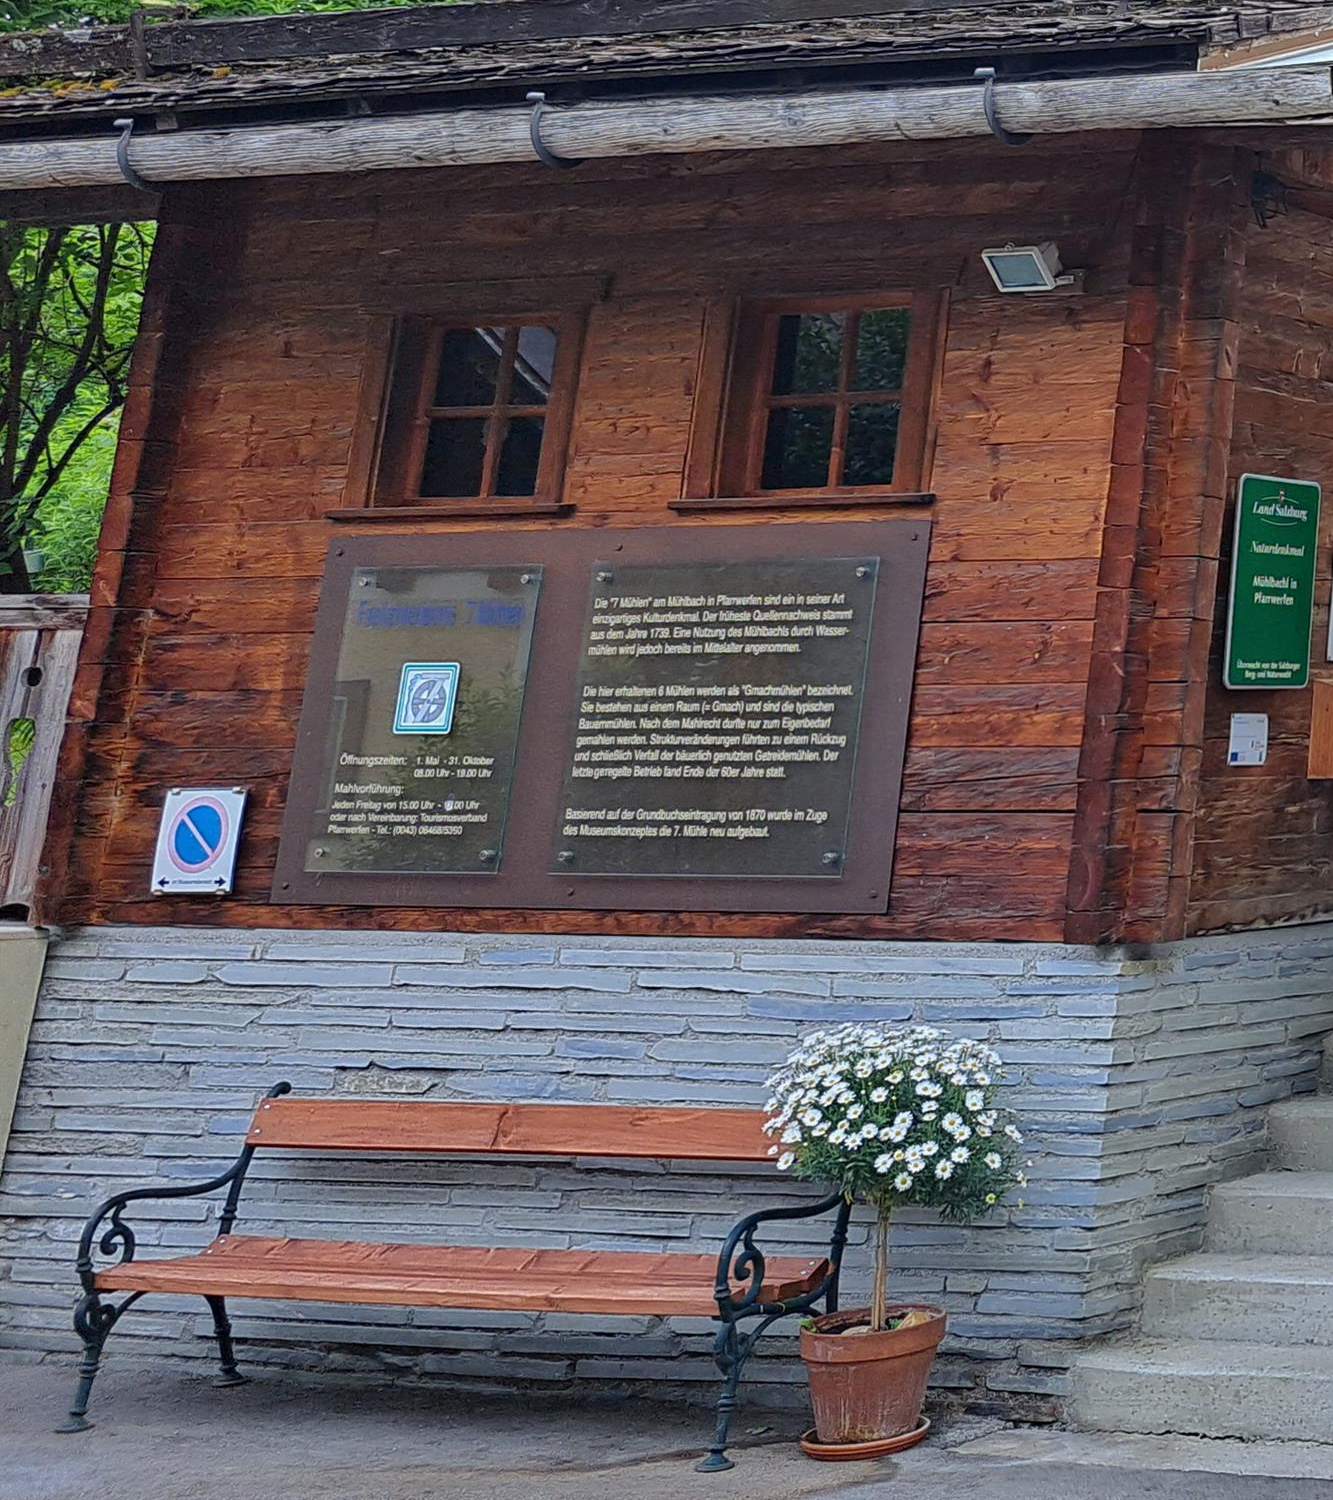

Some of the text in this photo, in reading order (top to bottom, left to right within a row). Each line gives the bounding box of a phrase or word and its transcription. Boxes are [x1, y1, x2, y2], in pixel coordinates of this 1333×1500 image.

[1252, 501, 1308, 522] Land Salzburg
[1250, 540, 1305, 556] Naturdenkmal
[1290, 578, 1297, 589] in
[594, 597, 608, 609] Die
[653, 598, 665, 607] am
[667, 595, 706, 607] Mühlbach
[707, 597, 715, 606] in
[716, 595, 762, 606] Pfarrwerfen
[764, 594, 782, 605] sind
[782, 594, 795, 604] ein
[796, 594, 804, 604] in
[806, 593, 831, 604] seiner
[832, 593, 846, 604] Art
[1254, 592, 1294, 605] Pfarrwerfen
[592, 609, 853, 626] einzigartiges Kulturdenkmal. Der früheste Quellennachweis stammt
[590, 630, 605, 640] aus
[606, 629, 624, 639] dem
[624, 628, 648, 639] Jahre
[650, 627, 671, 639] 1739.
[673, 627, 691, 638] Eine
[693, 627, 726, 640] Nutzung
[727, 627, 742, 637] des
[790, 625, 814, 636] durch
[816, 625, 850, 636] Wasser-
[587, 642, 801, 657] mühlen wird jedoch bereits im Mittelalter angenommen.
[583, 686, 597, 697] Die
[598, 686, 615, 696] hier
[615, 685, 657, 696] erhaltenen
[658, 686, 664, 696] 6
[665, 685, 695, 696] Mühlen
[696, 685, 726, 696] werden
[727, 685, 740, 696] als
[807, 684, 854, 696] bezeichnet.
[580, 701, 594, 713] Sie
[595, 701, 632, 713] bestehen
[633, 703, 648, 712] aus
[650, 701, 674, 712] einem
[676, 701, 700, 712] Raum
[745, 701, 762, 712] und
[762, 701, 780, 712] sind
[781, 701, 794, 712] die
[796, 701, 835, 714] typischen
[639, 717, 661, 729] Nach
[662, 718, 680, 729] dem
[722, 718, 746, 729] durfte
[747, 719, 762, 728] nur
[763, 719, 780, 728] zum
[781, 717, 831, 731] Eigenbedarf
[576, 733, 846, 748] gemahlen werden. Strukturveränderungen führten zu einem Rückzug
[339, 753, 408, 767] Öffnungszeiten:
[417, 756, 424, 765] 1.
[425, 756, 440, 765] Mai
[448, 756, 461, 765] 31.
[462, 756, 494, 765] Oktober
[574, 749, 839, 763] und schließlich Verfall der bäuerlich genutzten Getreidemühlen. Der
[436, 769, 450, 778] Uhr
[477, 769, 493, 778] Uhr
[571, 766, 594, 777] letzte
[633, 766, 662, 777] Betrieb
[663, 766, 682, 777] fand
[683, 766, 704, 777] Ende
[706, 766, 720, 777] der
[741, 766, 765, 777] Jahre
[765, 766, 786, 777] statt.
[334, 783, 405, 797] Mahlvorführung:
[332, 800, 355, 809] Jeden
[355, 801, 382, 811] Freitag
[420, 801, 435, 810] Uhr
[465, 801, 480, 810] Uhr
[329, 813, 488, 824] oder nach Vereinbarung: Tourismusverband
[565, 808, 828, 824] Basierend auf der Grundbuchseintragung von 1870 wurde im Zuge
[562, 825, 578, 835] des
[579, 825, 658, 840] Museumskonzeptes
[659, 825, 672, 836] die
[683, 825, 708, 836] Mühle
[710, 827, 726, 836] neu
[727, 826, 770, 840] aufgebaut.
